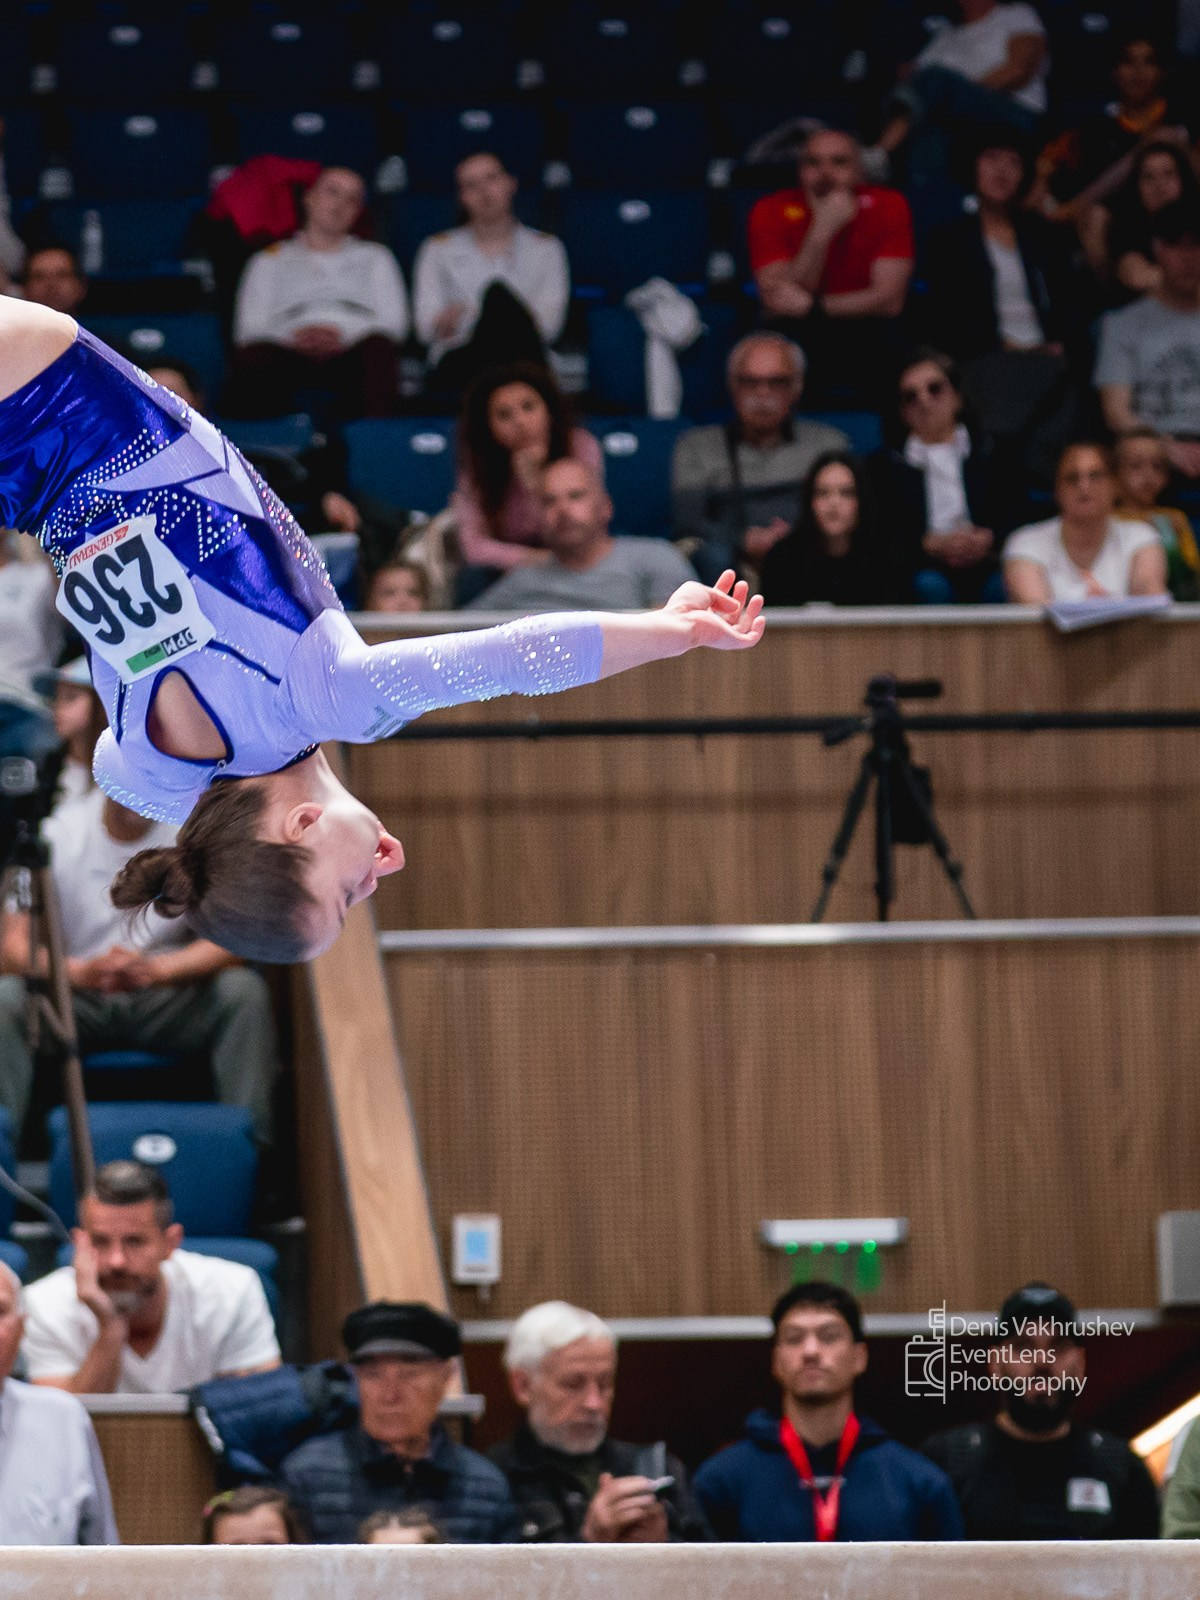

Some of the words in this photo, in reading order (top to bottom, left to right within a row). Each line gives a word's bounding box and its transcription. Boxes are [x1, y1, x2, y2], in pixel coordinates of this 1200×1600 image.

[70, 533, 115, 569] GENERALI
[64, 533, 183, 645] 236
[162, 627, 198, 657] DPM
